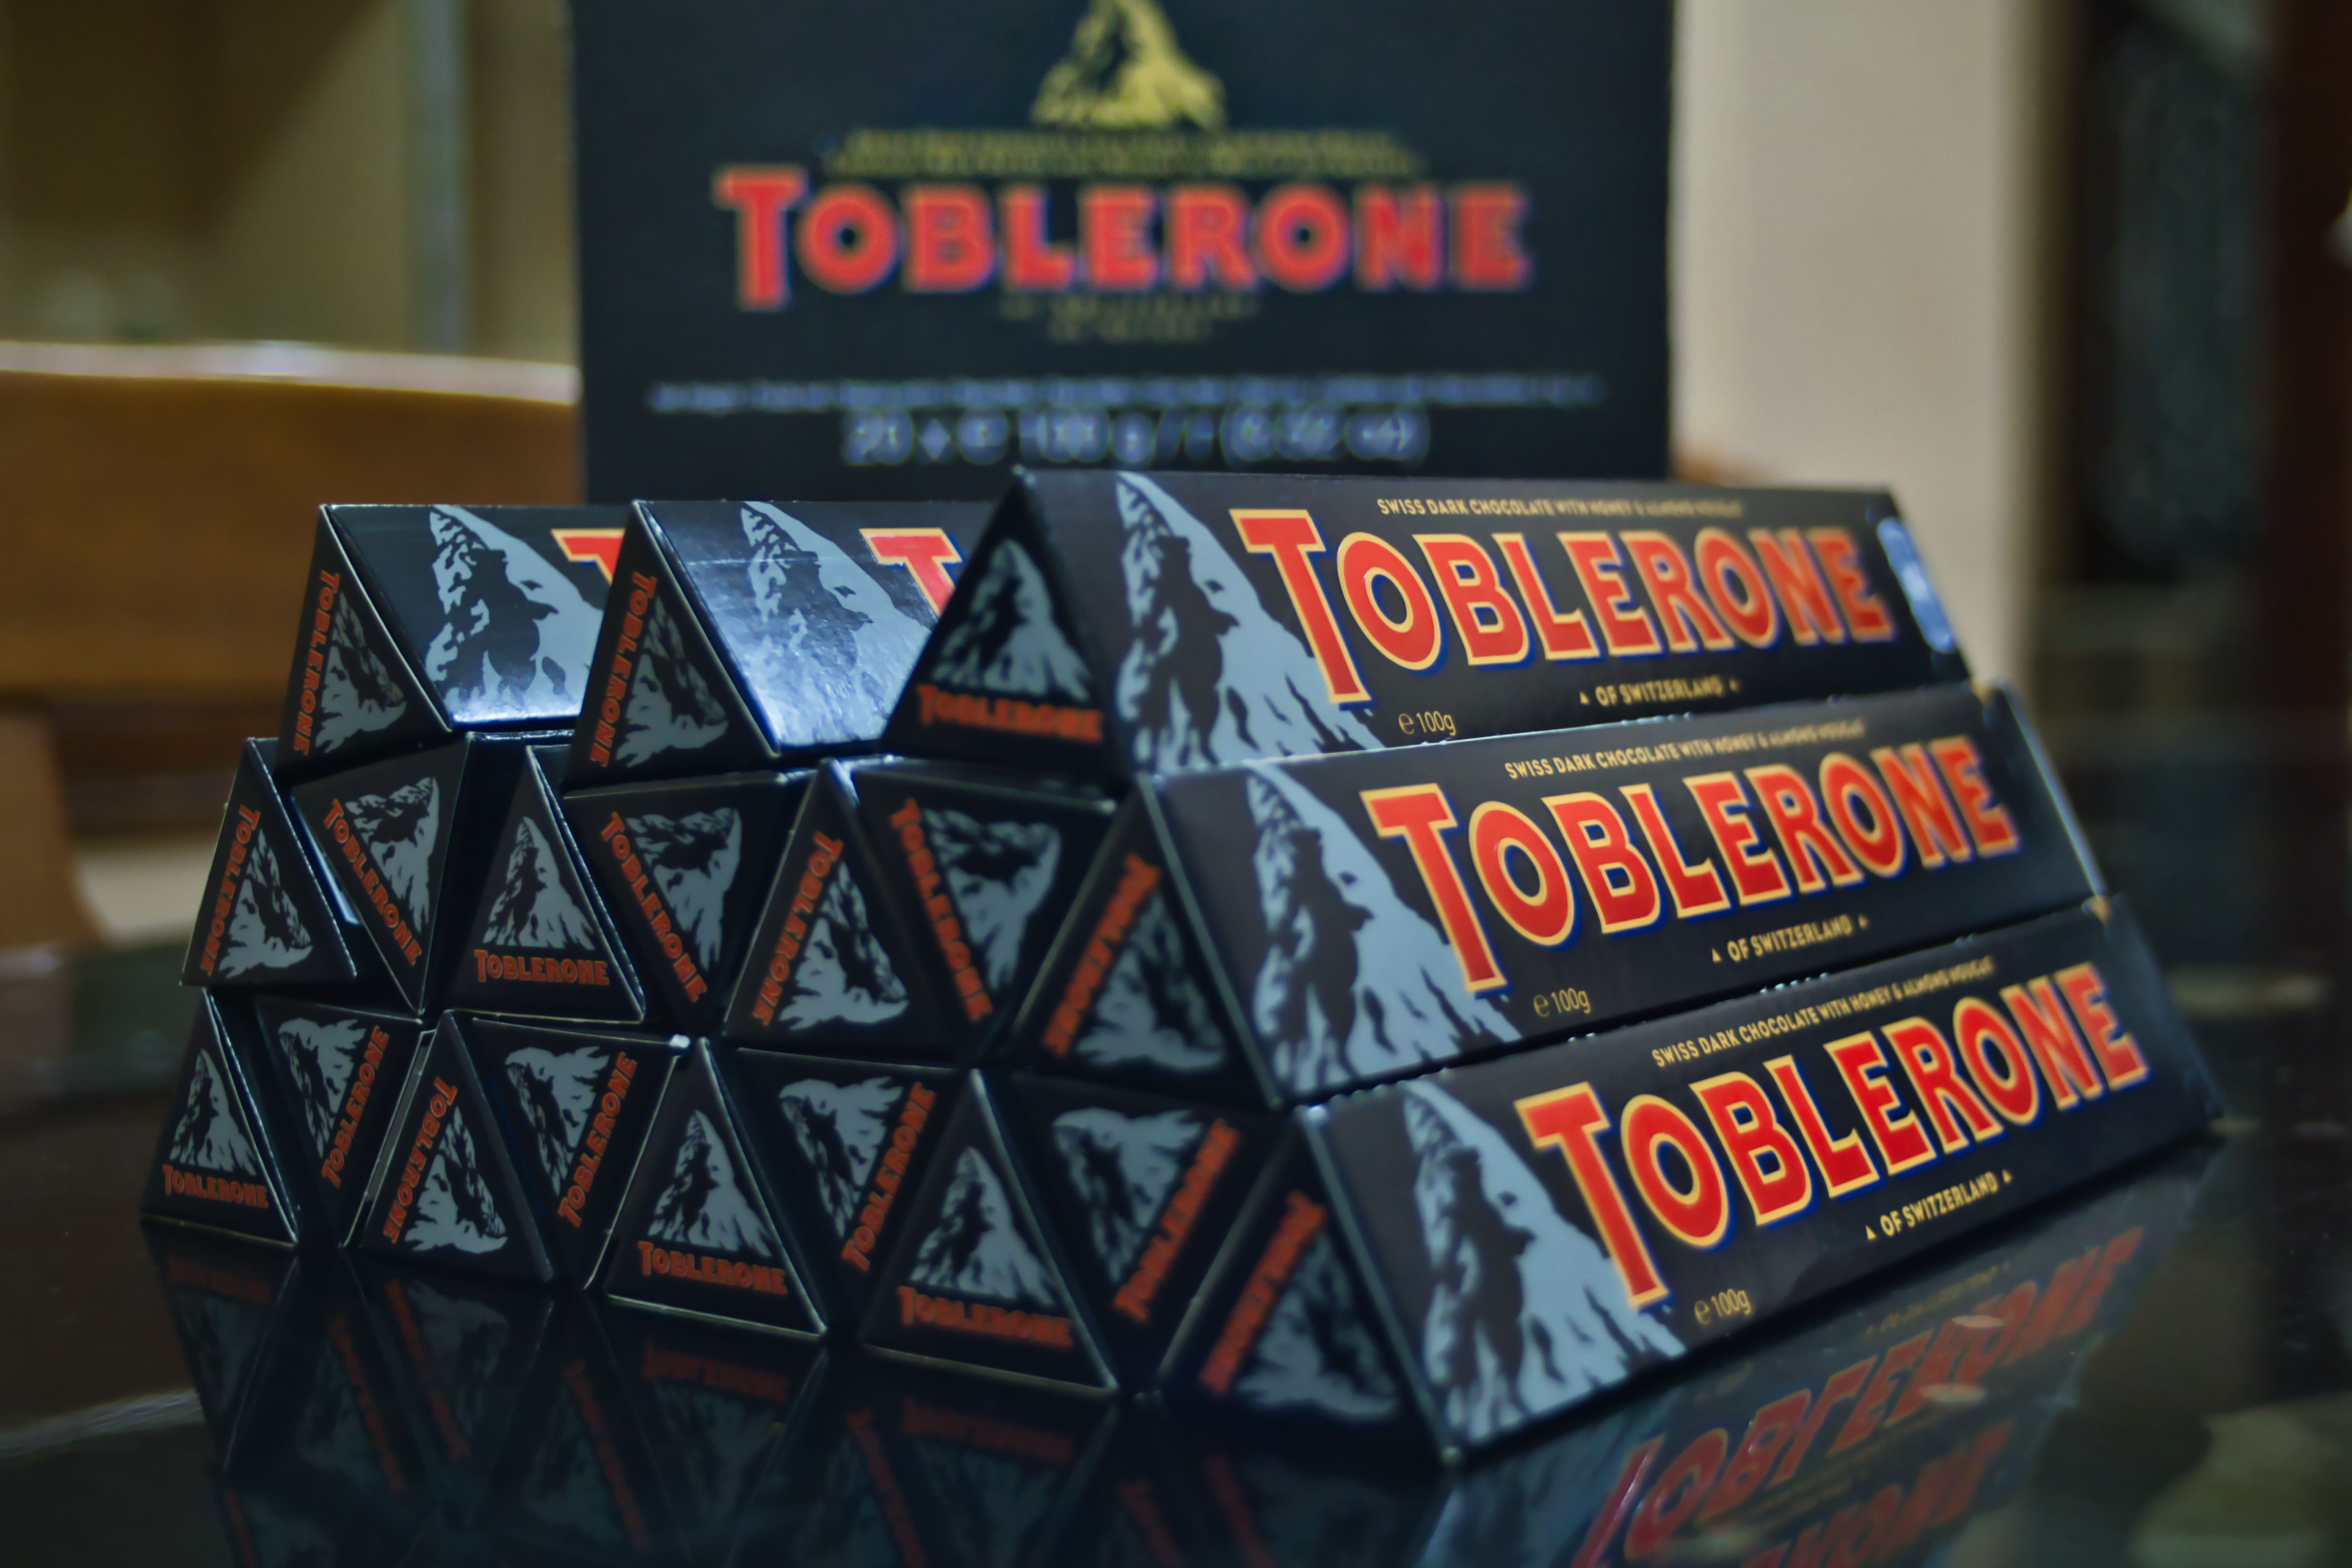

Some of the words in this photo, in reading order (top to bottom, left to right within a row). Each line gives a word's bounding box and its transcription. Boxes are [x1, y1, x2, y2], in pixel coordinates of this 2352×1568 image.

[717, 169, 1527, 308] TOBLERONE
[1377, 498, 1426, 515] SWISS
[1426, 498, 1470, 515] DARK
[1469, 498, 1555, 516] CHOCOLATE
[294, 570, 341, 755] TOBLERONE
[591, 571, 657, 767] TOBLERONE
[1229, 509, 1894, 706] TOBLERONE
[1416, 710, 1456, 736] 100g
[1504, 758, 1553, 780] SWISS
[1552, 753, 1596, 773] DARK
[1595, 742, 1681, 768] CHOCOLATE
[1678, 739, 1714, 757] WITH
[1595, 685, 1617, 706] OF
[1619, 674, 1723, 705] SWITZERLAND
[200, 804, 261, 976] TOBLERONE
[324, 799, 421, 965] TOBLERONE
[601, 811, 707, 1002] TOBLERONE
[752, 831, 843, 1025] TOBLERONE
[1359, 737, 2021, 994] TOBLERONE
[1727, 938, 1748, 963] OF
[1750, 914, 1853, 957] SWITZERLAND
[474, 949, 609, 985] TOBLERONE
[1551, 987, 1591, 1014] 100g
[1651, 1040, 1699, 1067] SWISS
[1697, 1029, 1741, 1054] DARK
[1739, 1006, 1820, 1043] CHOCOLATE
[1816, 997, 1851, 1020] WITH
[321, 1026, 389, 1188] TOBLERONE
[383, 1077, 458, 1244] TOBLERONE
[558, 1053, 637, 1227] TOBLERONE
[841, 1082, 936, 1272] TOBLERONE
[1513, 961, 2149, 1309] TOBLERONE
[162, 1164, 269, 1209] TOBLERONE
[1880, 1210, 1902, 1237] OF
[1902, 1171, 1998, 1228] SWITZERLAND
[637, 1241, 788, 1295] TOBLERONE
[1711, 1289, 1751, 1318] 100g
